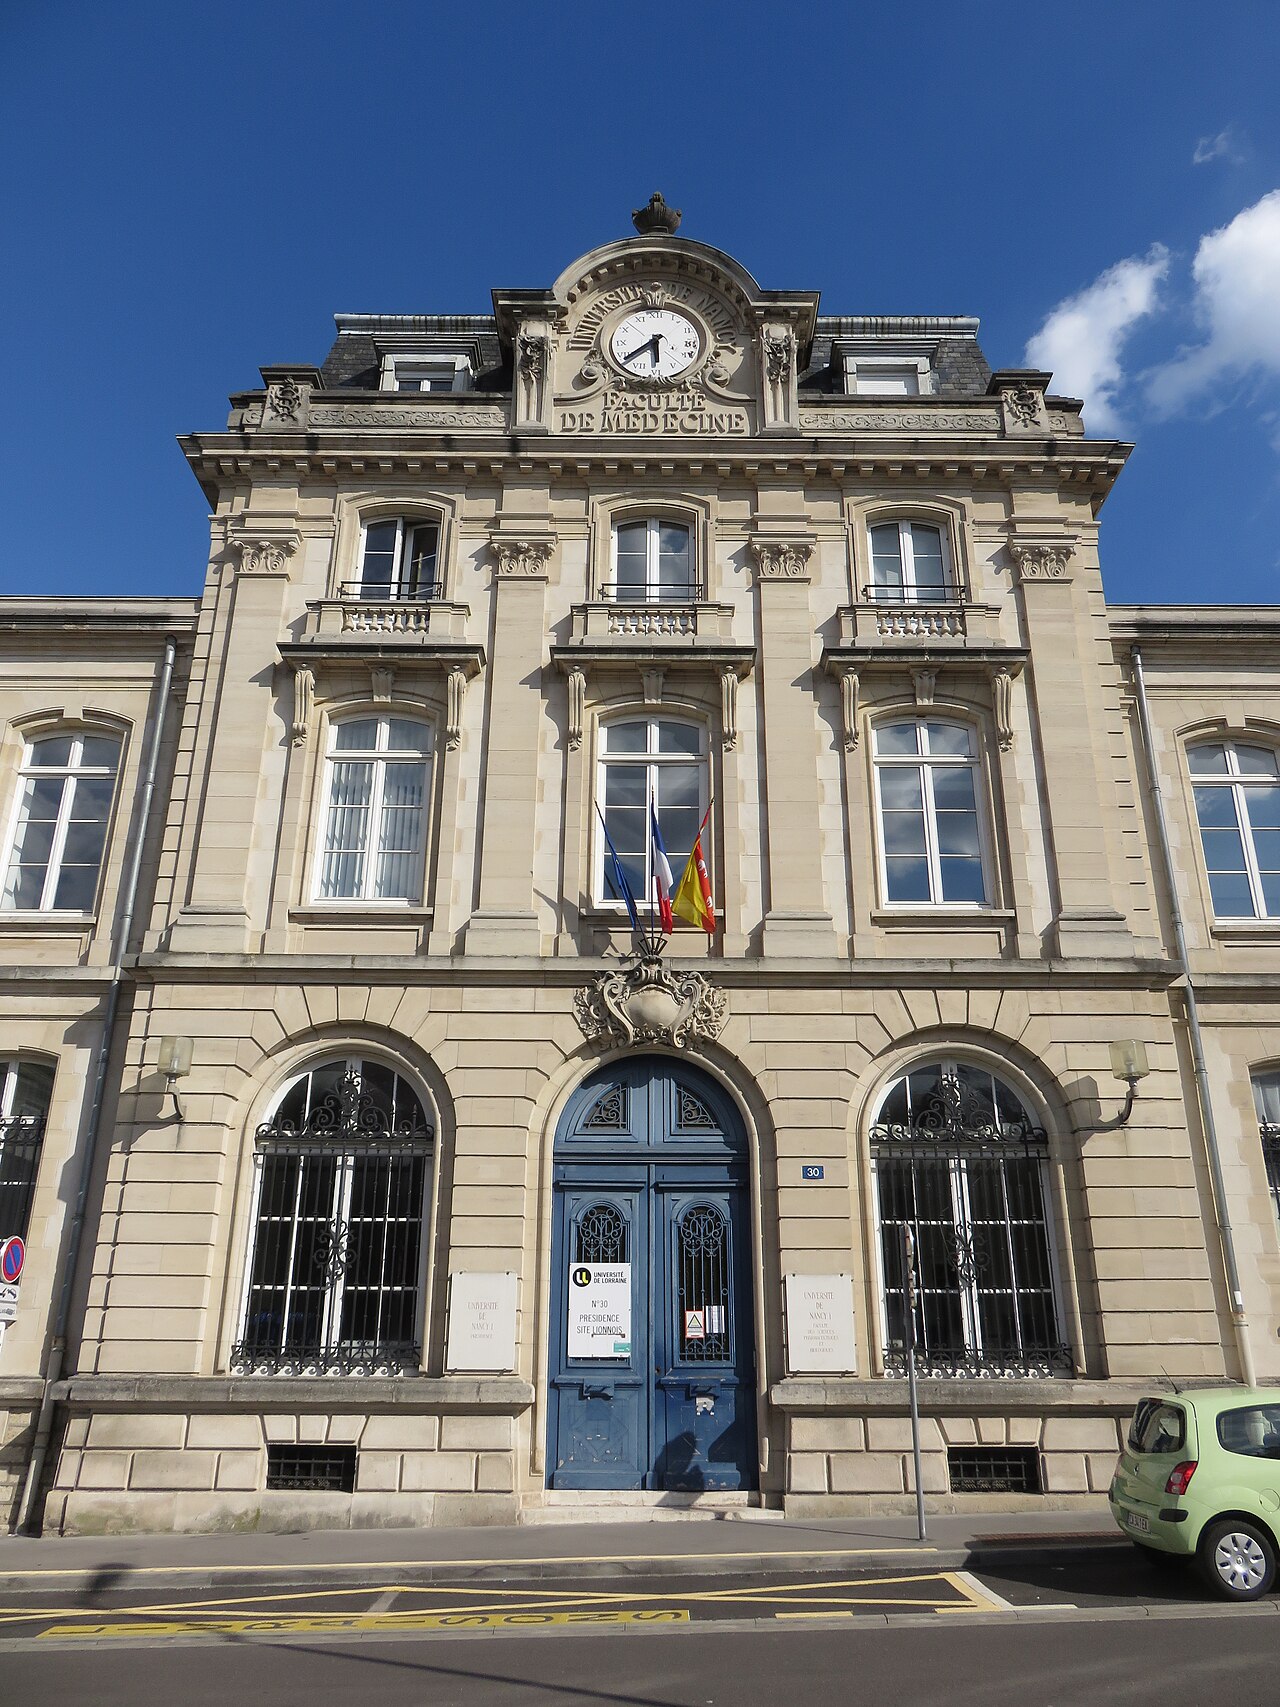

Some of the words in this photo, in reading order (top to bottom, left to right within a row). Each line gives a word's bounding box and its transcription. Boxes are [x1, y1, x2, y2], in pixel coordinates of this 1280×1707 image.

[699, 296, 736, 355] NANCY
[560, 412, 595, 433] DE
[807, 1167, 820, 1177] 30
[815, 1301, 824, 1310] DE
[576, 1325, 590, 1334] SITE
[592, 1325, 623, 1335] LIONNOIS
[48, 1610, 683, 1636] LIVRAISONS
